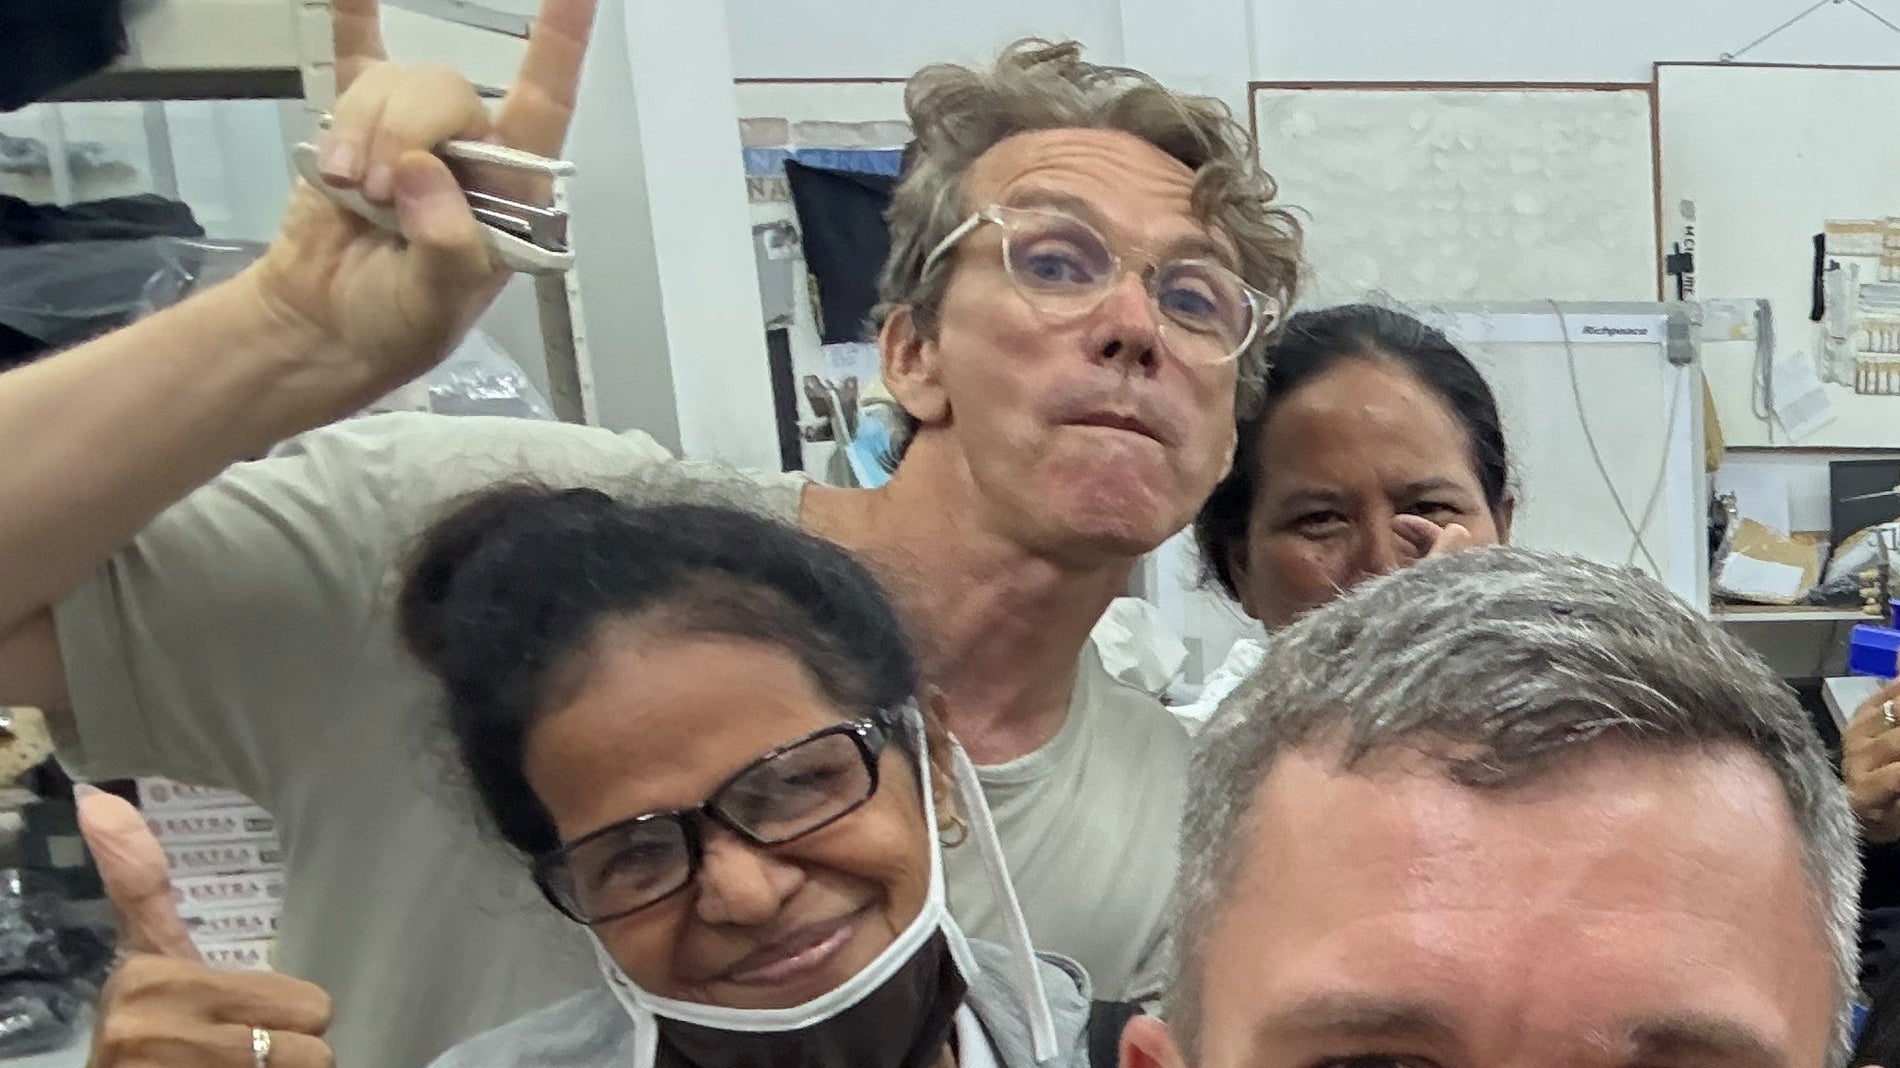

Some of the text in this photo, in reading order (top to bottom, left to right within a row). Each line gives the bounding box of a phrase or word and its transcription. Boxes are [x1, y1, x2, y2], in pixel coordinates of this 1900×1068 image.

[165, 817, 237, 834] EXTRA
[181, 848, 251, 866] EXTRA
[189, 882, 260, 899] EXTRA
[203, 916, 264, 934] XTRA
[206, 949, 261, 967] XTRA
